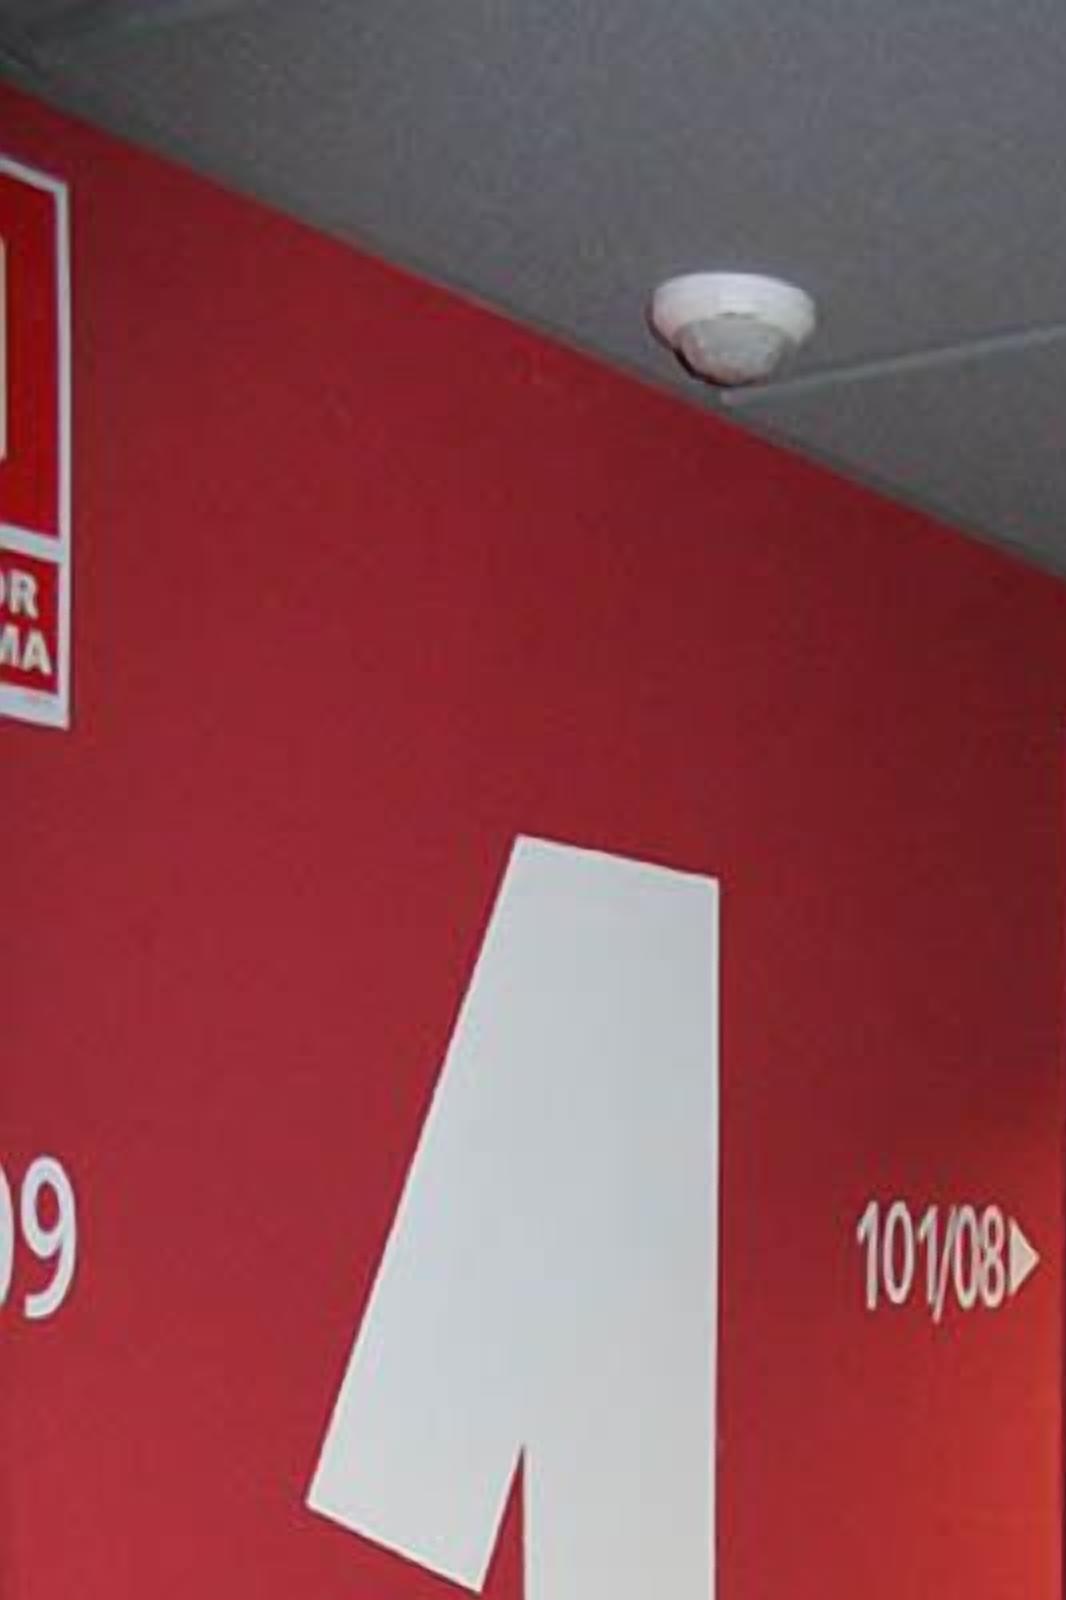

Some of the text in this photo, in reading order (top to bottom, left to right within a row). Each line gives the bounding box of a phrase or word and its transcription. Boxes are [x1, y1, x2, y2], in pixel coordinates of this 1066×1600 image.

[0, 569, 39, 620] R
[0, 1156, 77, 1319] 9
[857, 1200, 1006, 1324] 101/08
